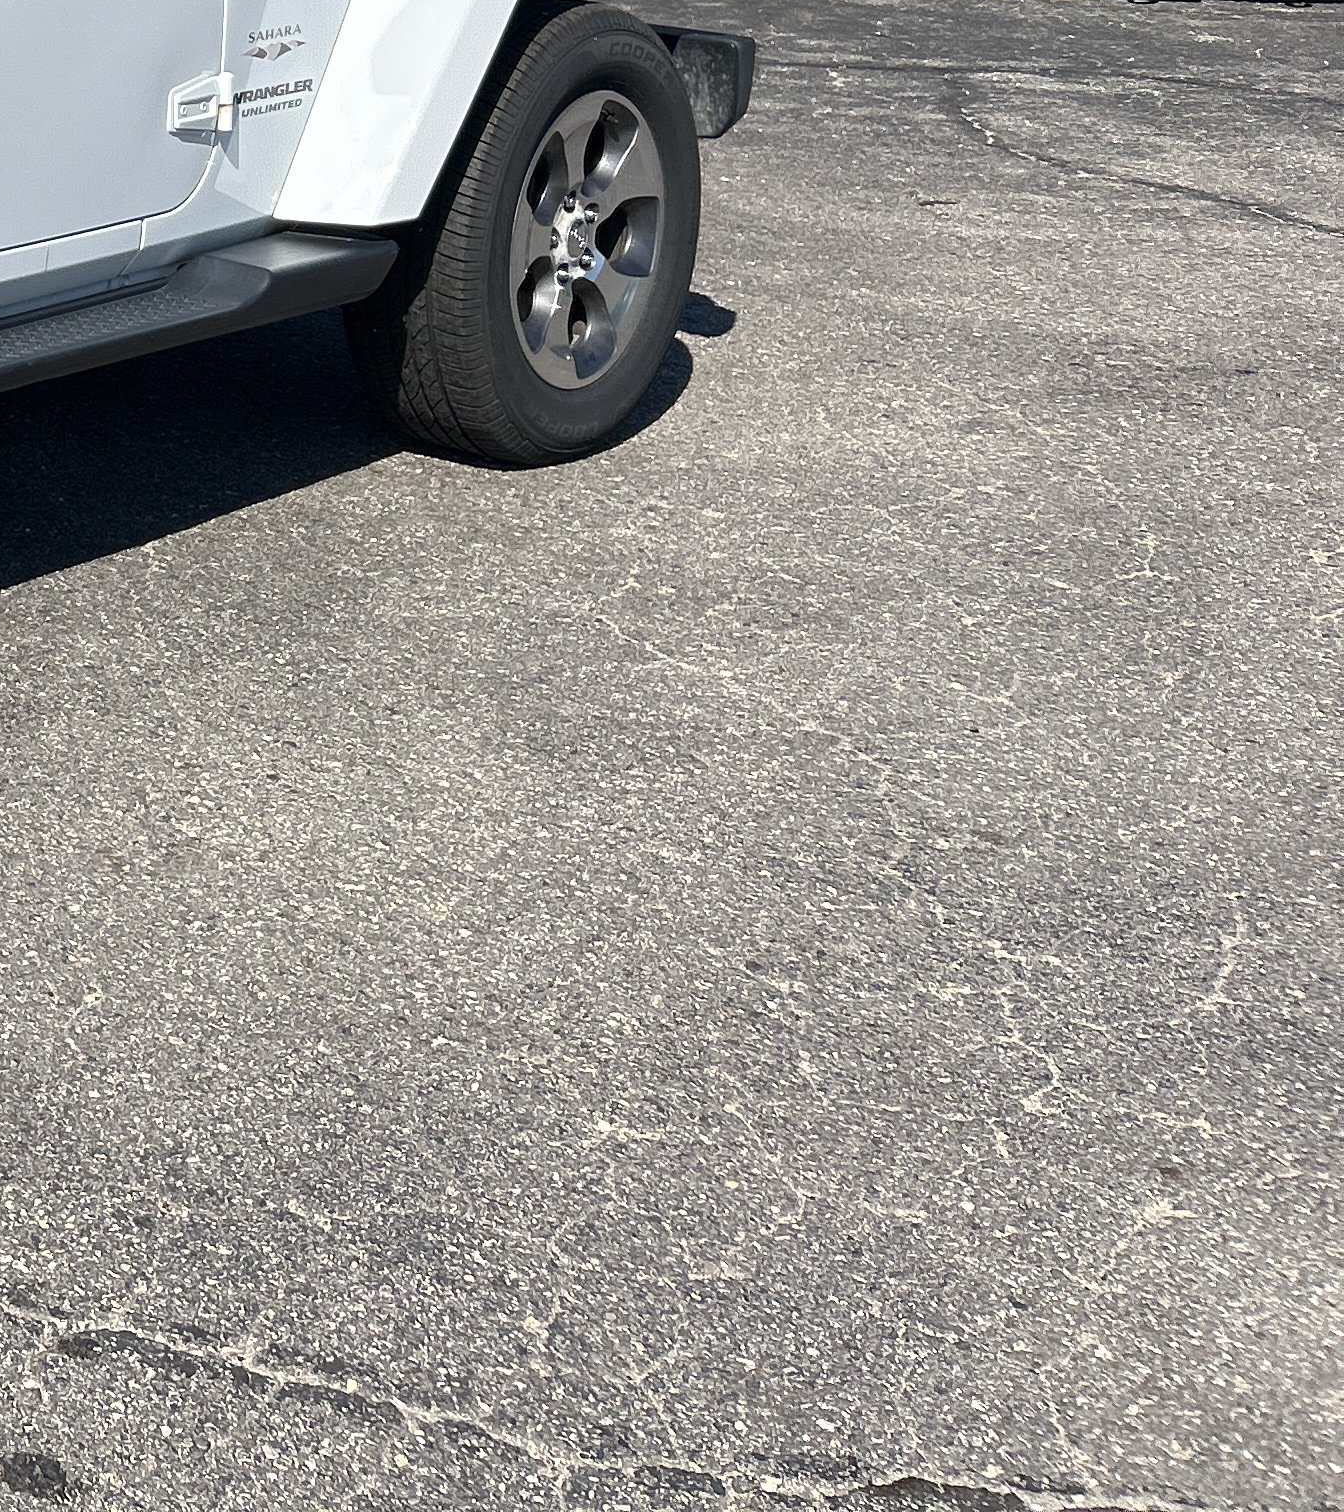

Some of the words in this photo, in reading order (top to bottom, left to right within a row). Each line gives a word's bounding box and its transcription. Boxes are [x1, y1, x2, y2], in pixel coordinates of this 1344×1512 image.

[248, 23, 302, 44] SAHARA
[232, 78, 314, 105] WRANGLER
[241, 98, 303, 118] UNLIMITED
